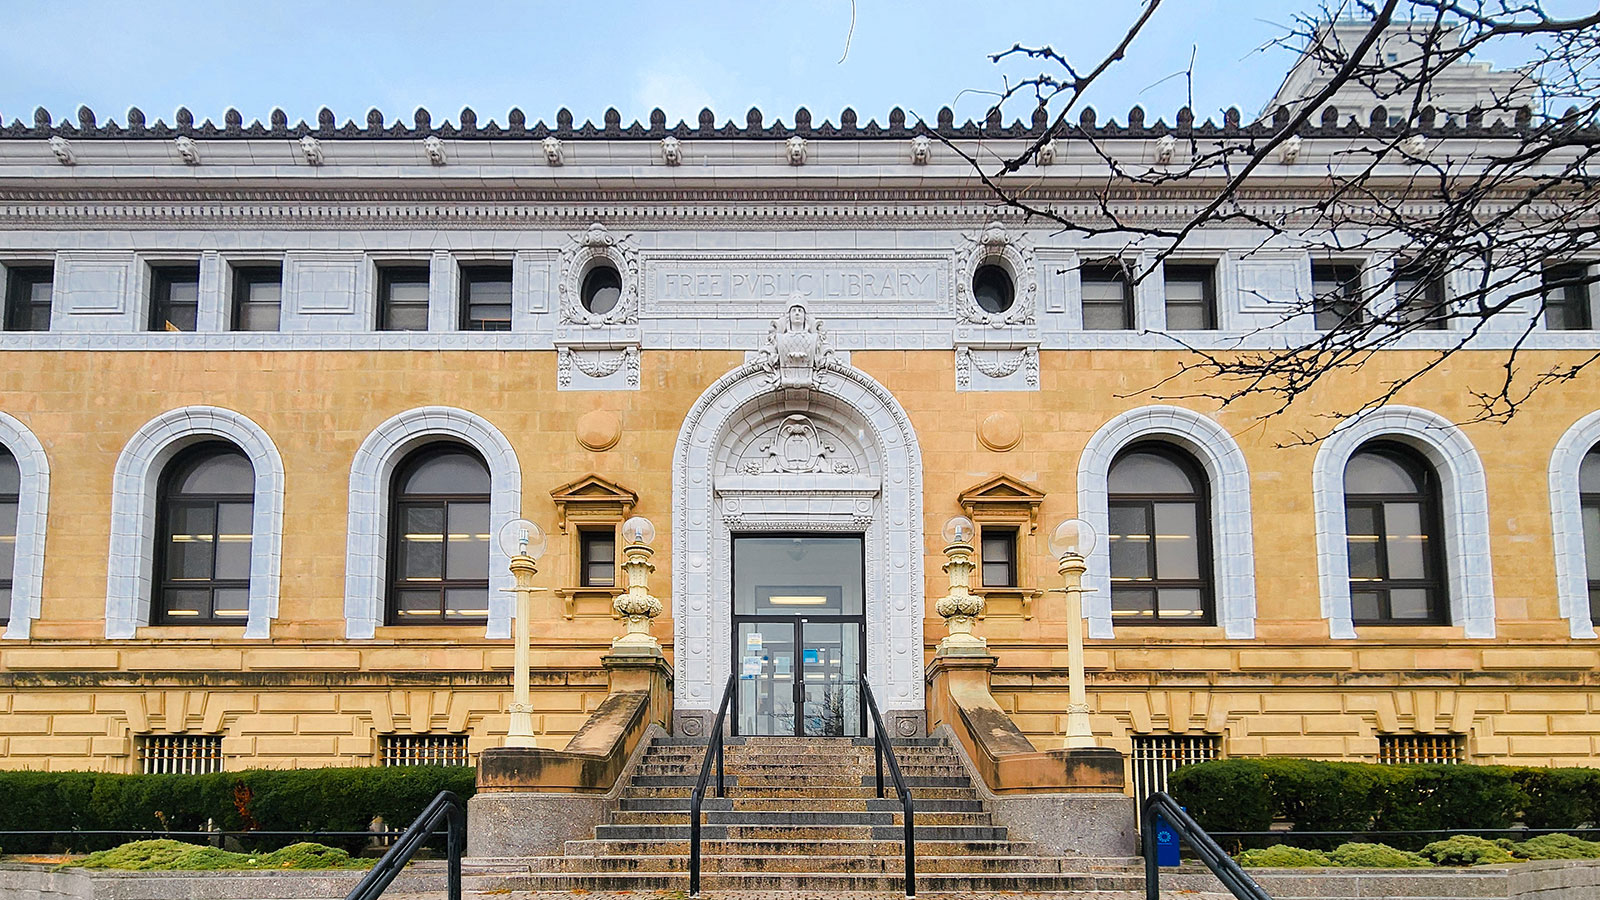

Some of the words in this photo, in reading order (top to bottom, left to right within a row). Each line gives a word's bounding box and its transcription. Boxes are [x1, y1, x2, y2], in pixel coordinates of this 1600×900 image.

[665, 274, 723, 297] FREE
[732, 274, 814, 297] PVBLIC
[825, 274, 930, 297] LIBRARY
